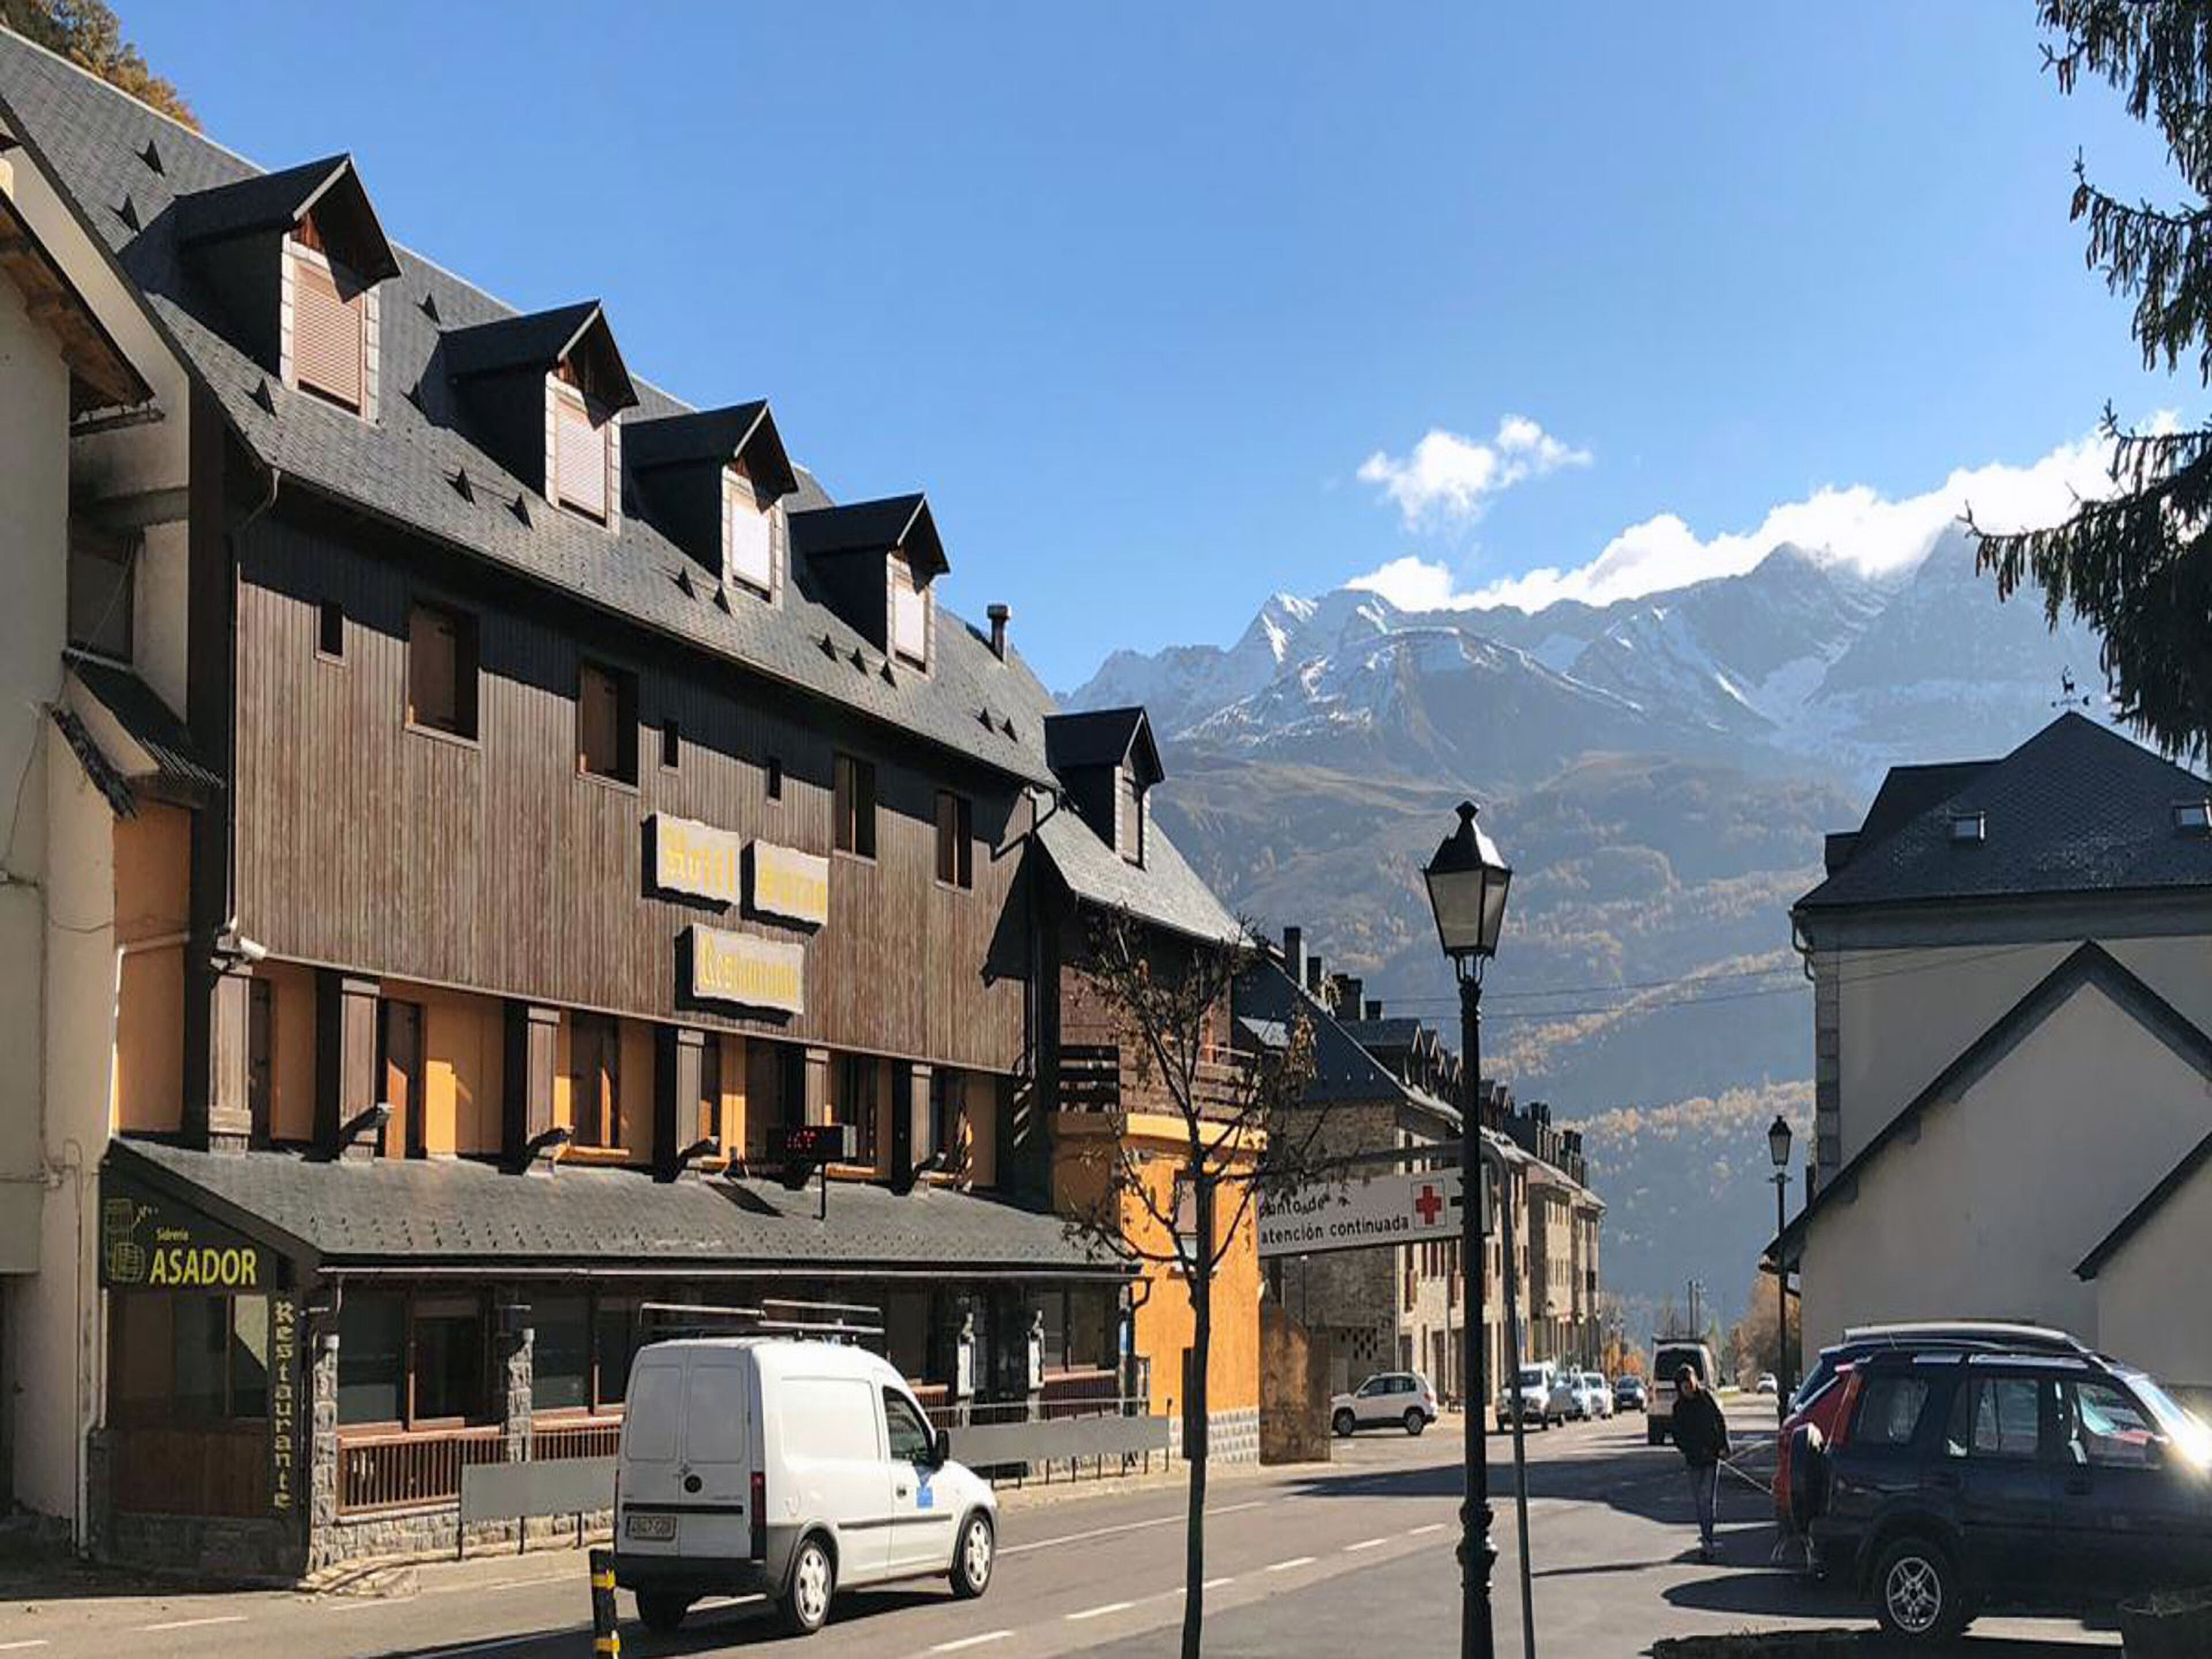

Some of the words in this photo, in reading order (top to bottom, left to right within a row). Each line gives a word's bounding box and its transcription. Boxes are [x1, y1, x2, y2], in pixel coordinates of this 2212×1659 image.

[1261, 1221, 1324, 1244] atención
[1330, 1214, 1410, 1238] continuada
[149, 1247, 258, 1286] ASADOR
[273, 1297, 296, 1512] Restaurante
